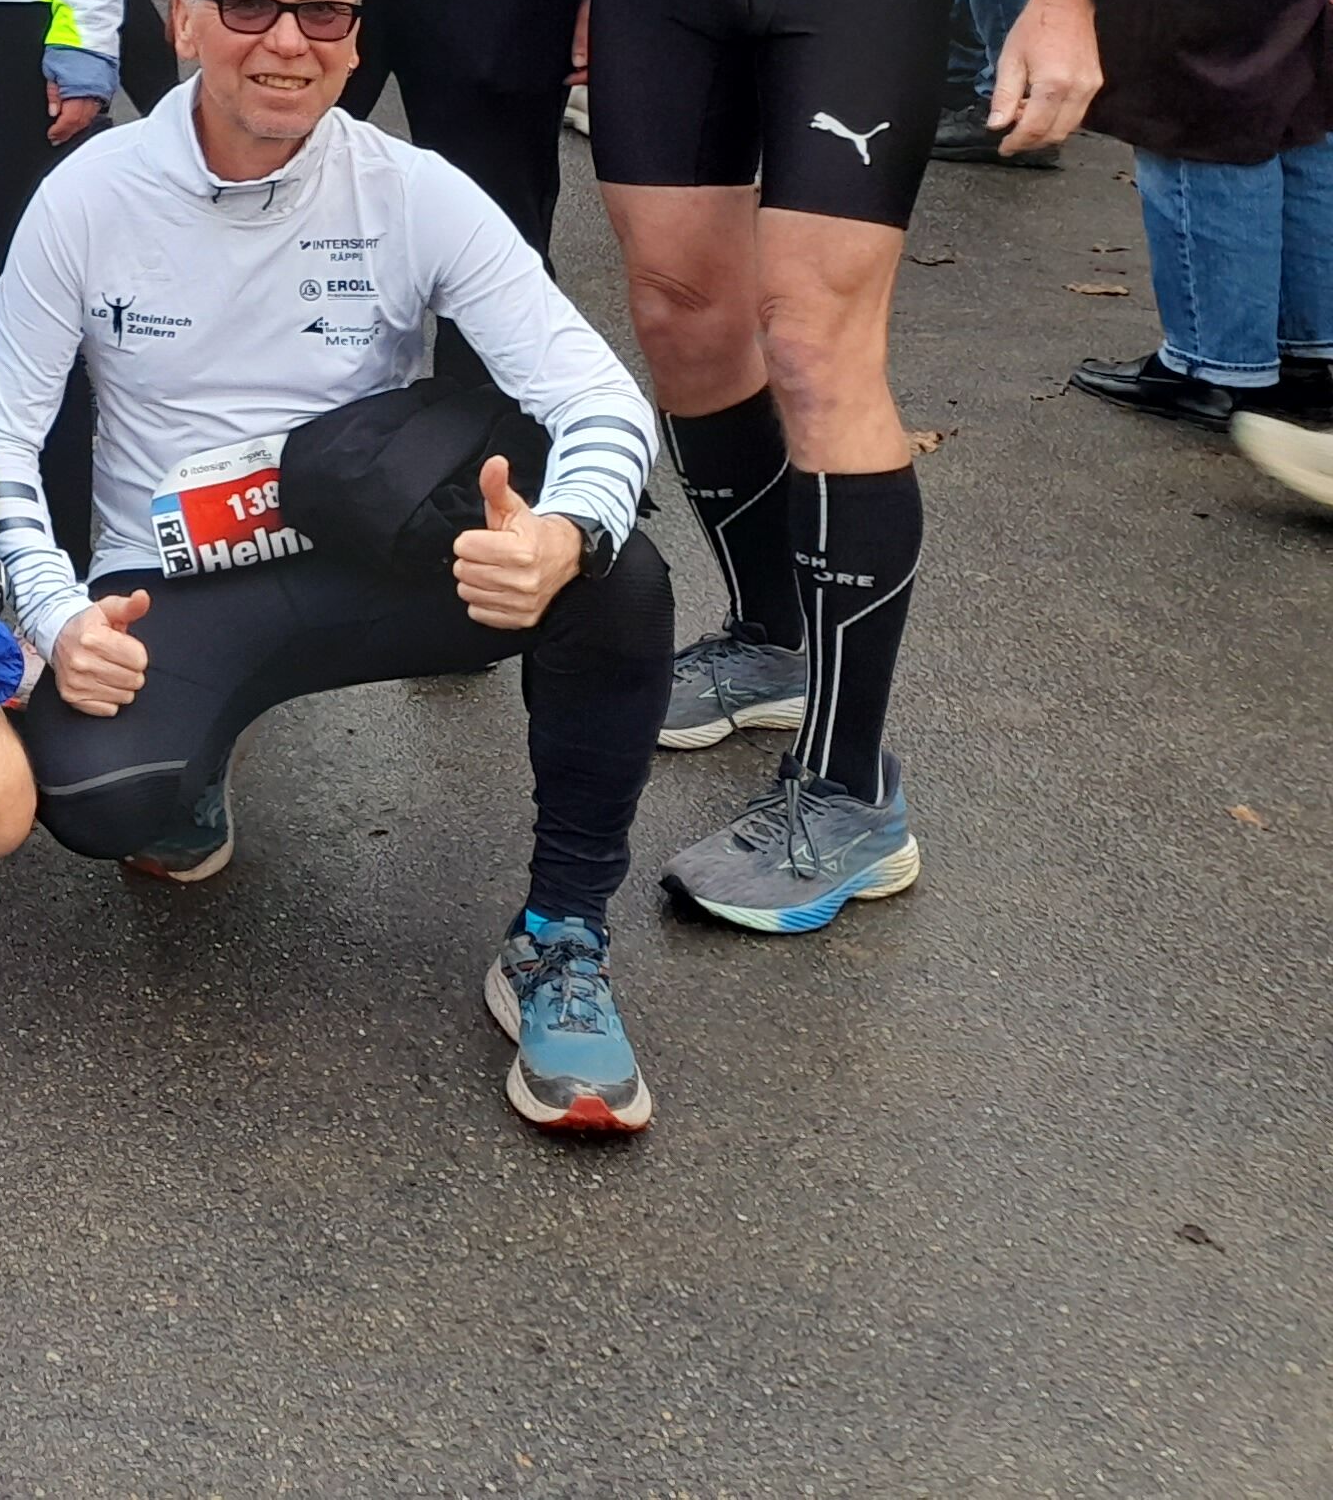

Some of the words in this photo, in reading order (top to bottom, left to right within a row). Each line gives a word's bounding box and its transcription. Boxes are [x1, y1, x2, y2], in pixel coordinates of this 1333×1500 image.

[91, 307, 108, 319] LG
[126, 312, 193, 328] Steinlach
[126, 324, 177, 339] Zollern
[190, 459, 233, 476] itdesign
